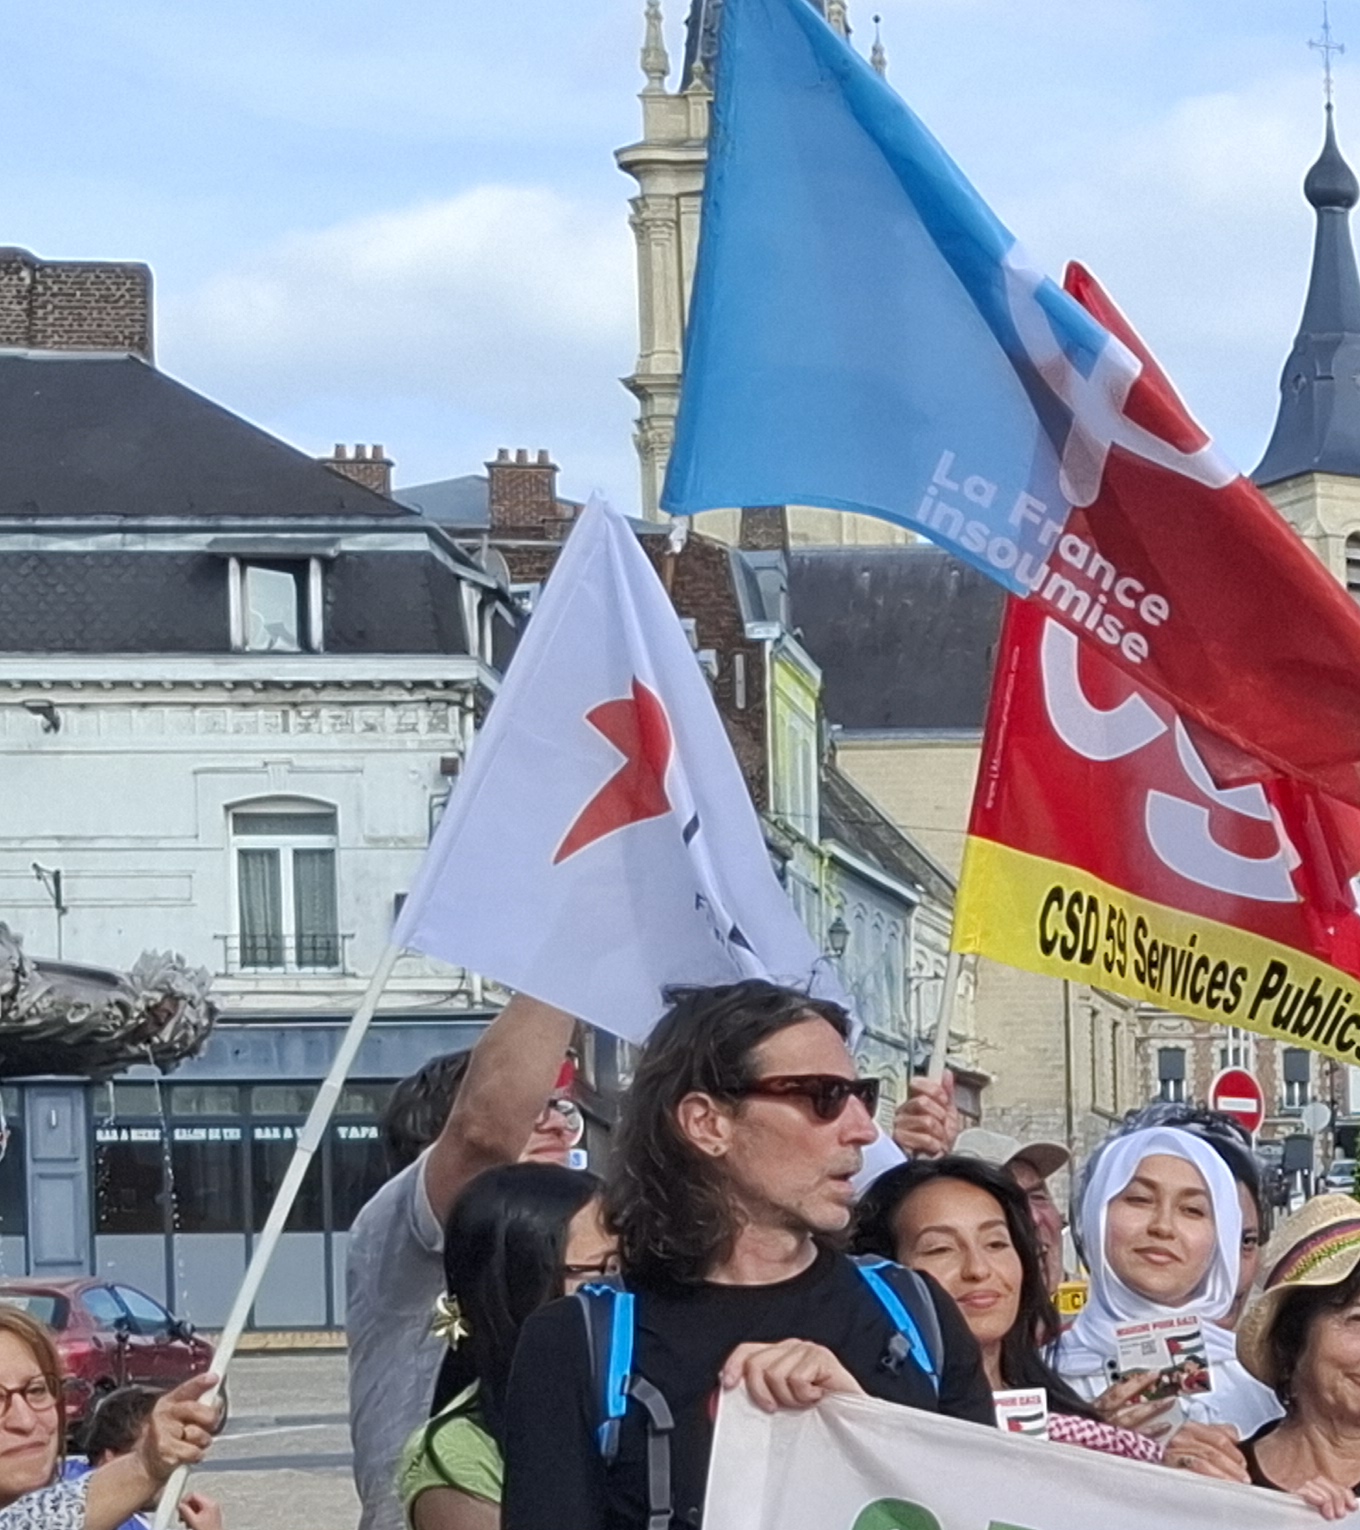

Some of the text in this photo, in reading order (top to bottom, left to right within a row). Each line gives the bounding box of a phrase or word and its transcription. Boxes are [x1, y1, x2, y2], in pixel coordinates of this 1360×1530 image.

[916, 485, 1149, 664] insoumise
[932, 450, 1170, 627] La France
[1038, 886, 1099, 966] CSD
[1102, 903, 1129, 979] 59
[1134, 915, 1248, 1015] Services
